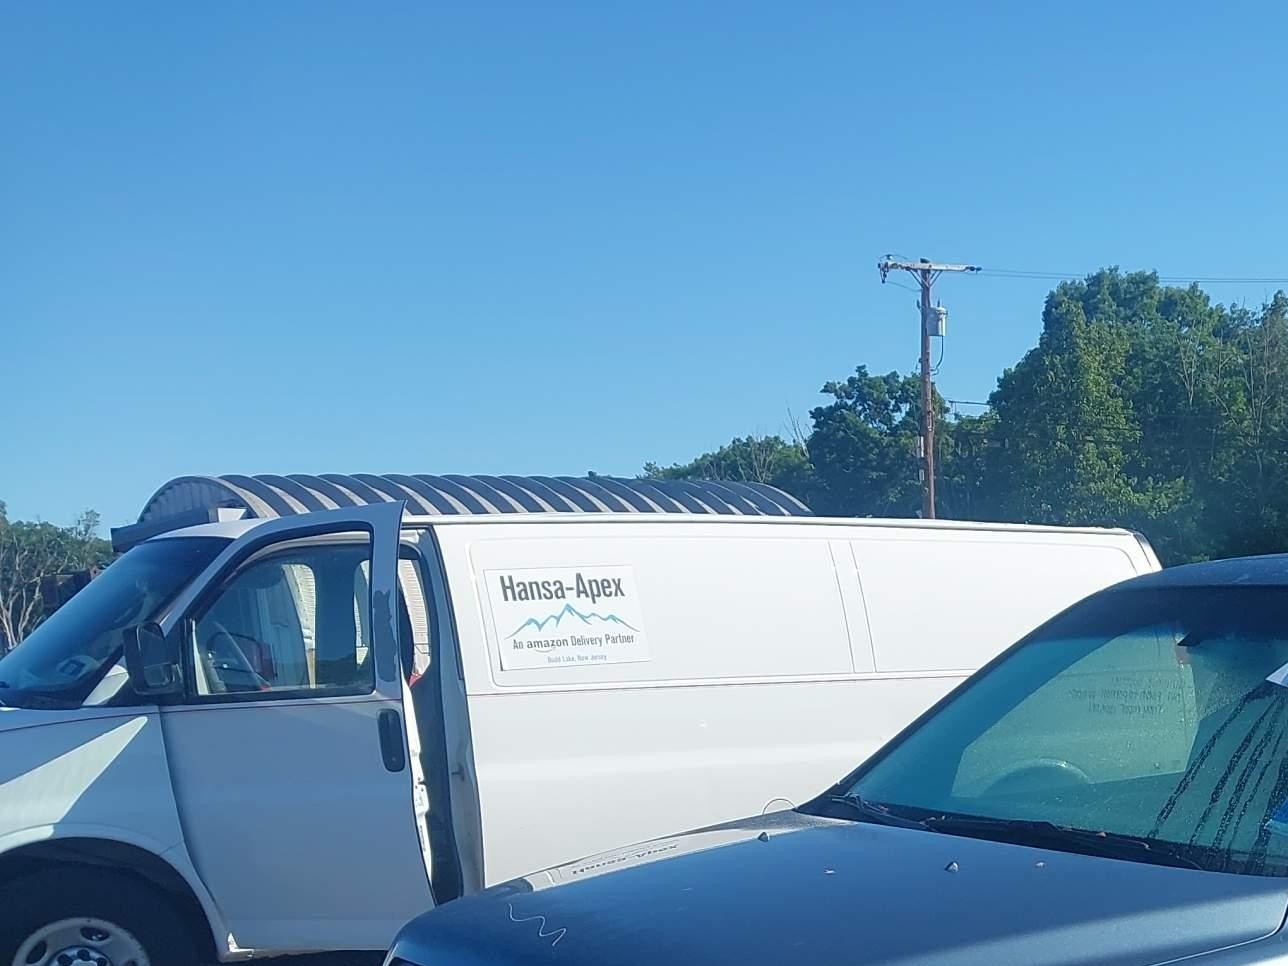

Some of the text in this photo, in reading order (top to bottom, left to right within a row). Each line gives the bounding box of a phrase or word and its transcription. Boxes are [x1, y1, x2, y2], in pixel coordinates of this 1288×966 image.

[499, 572, 626, 604] Hansa-Apex
[512, 633, 635, 650] An amazon Delivery Partner
